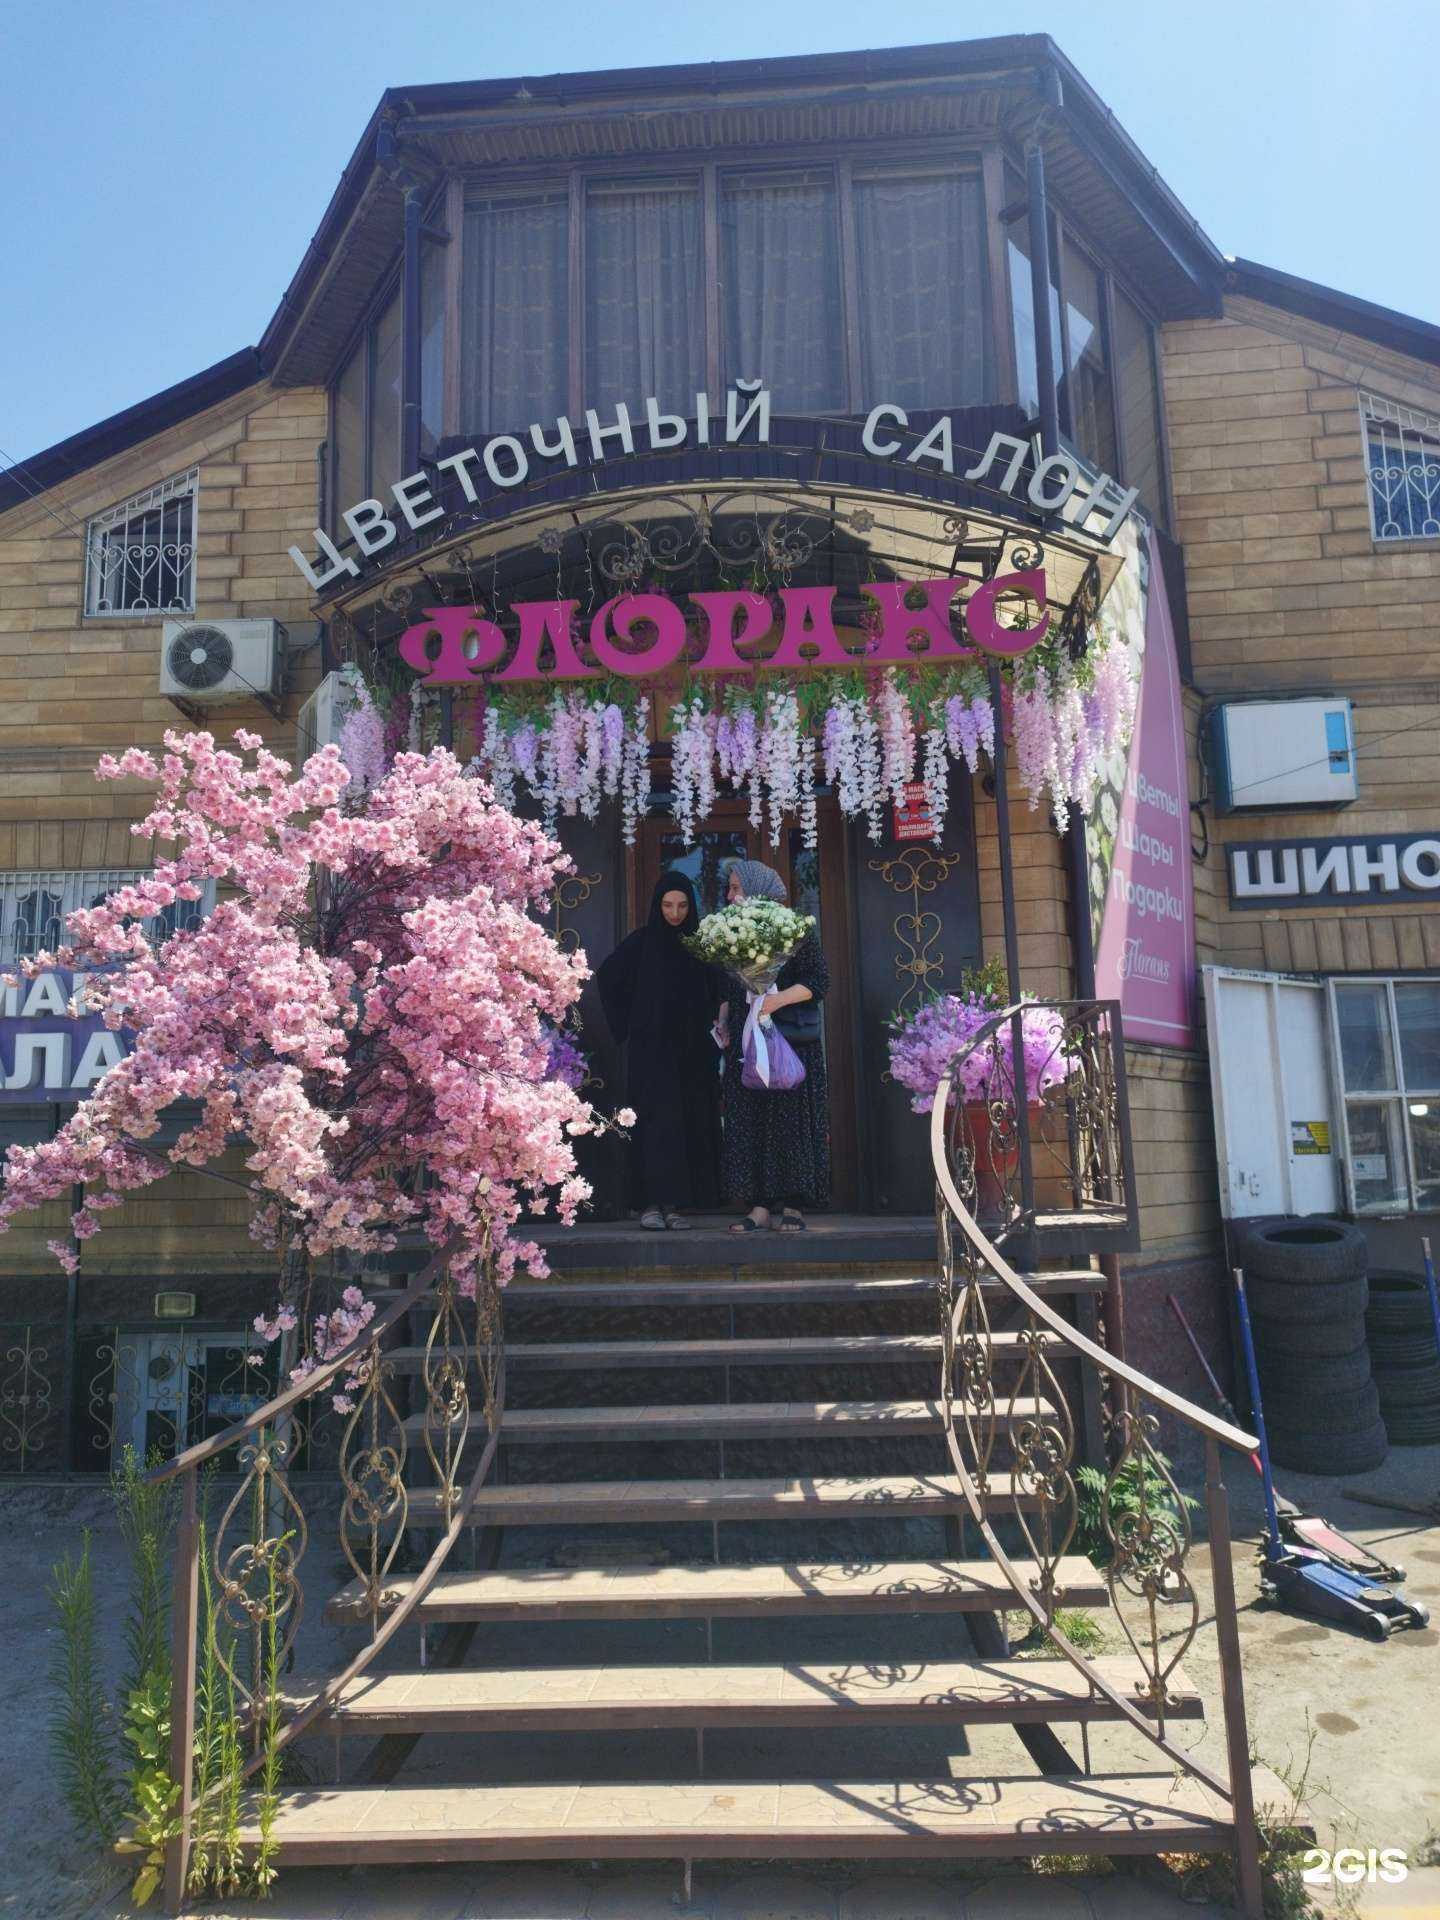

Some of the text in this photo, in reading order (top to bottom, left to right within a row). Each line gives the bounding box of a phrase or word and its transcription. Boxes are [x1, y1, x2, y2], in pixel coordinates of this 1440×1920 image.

[287, 378, 1140, 592] ЦВЕТОЧНЫЙ САЛОН
[399, 568, 1049, 685] ФЛОРАНС
[1120, 817, 1174, 866] Шары
[1233, 840, 1440, 896] ШИНО
[1112, 868, 1183, 922] Подарки
